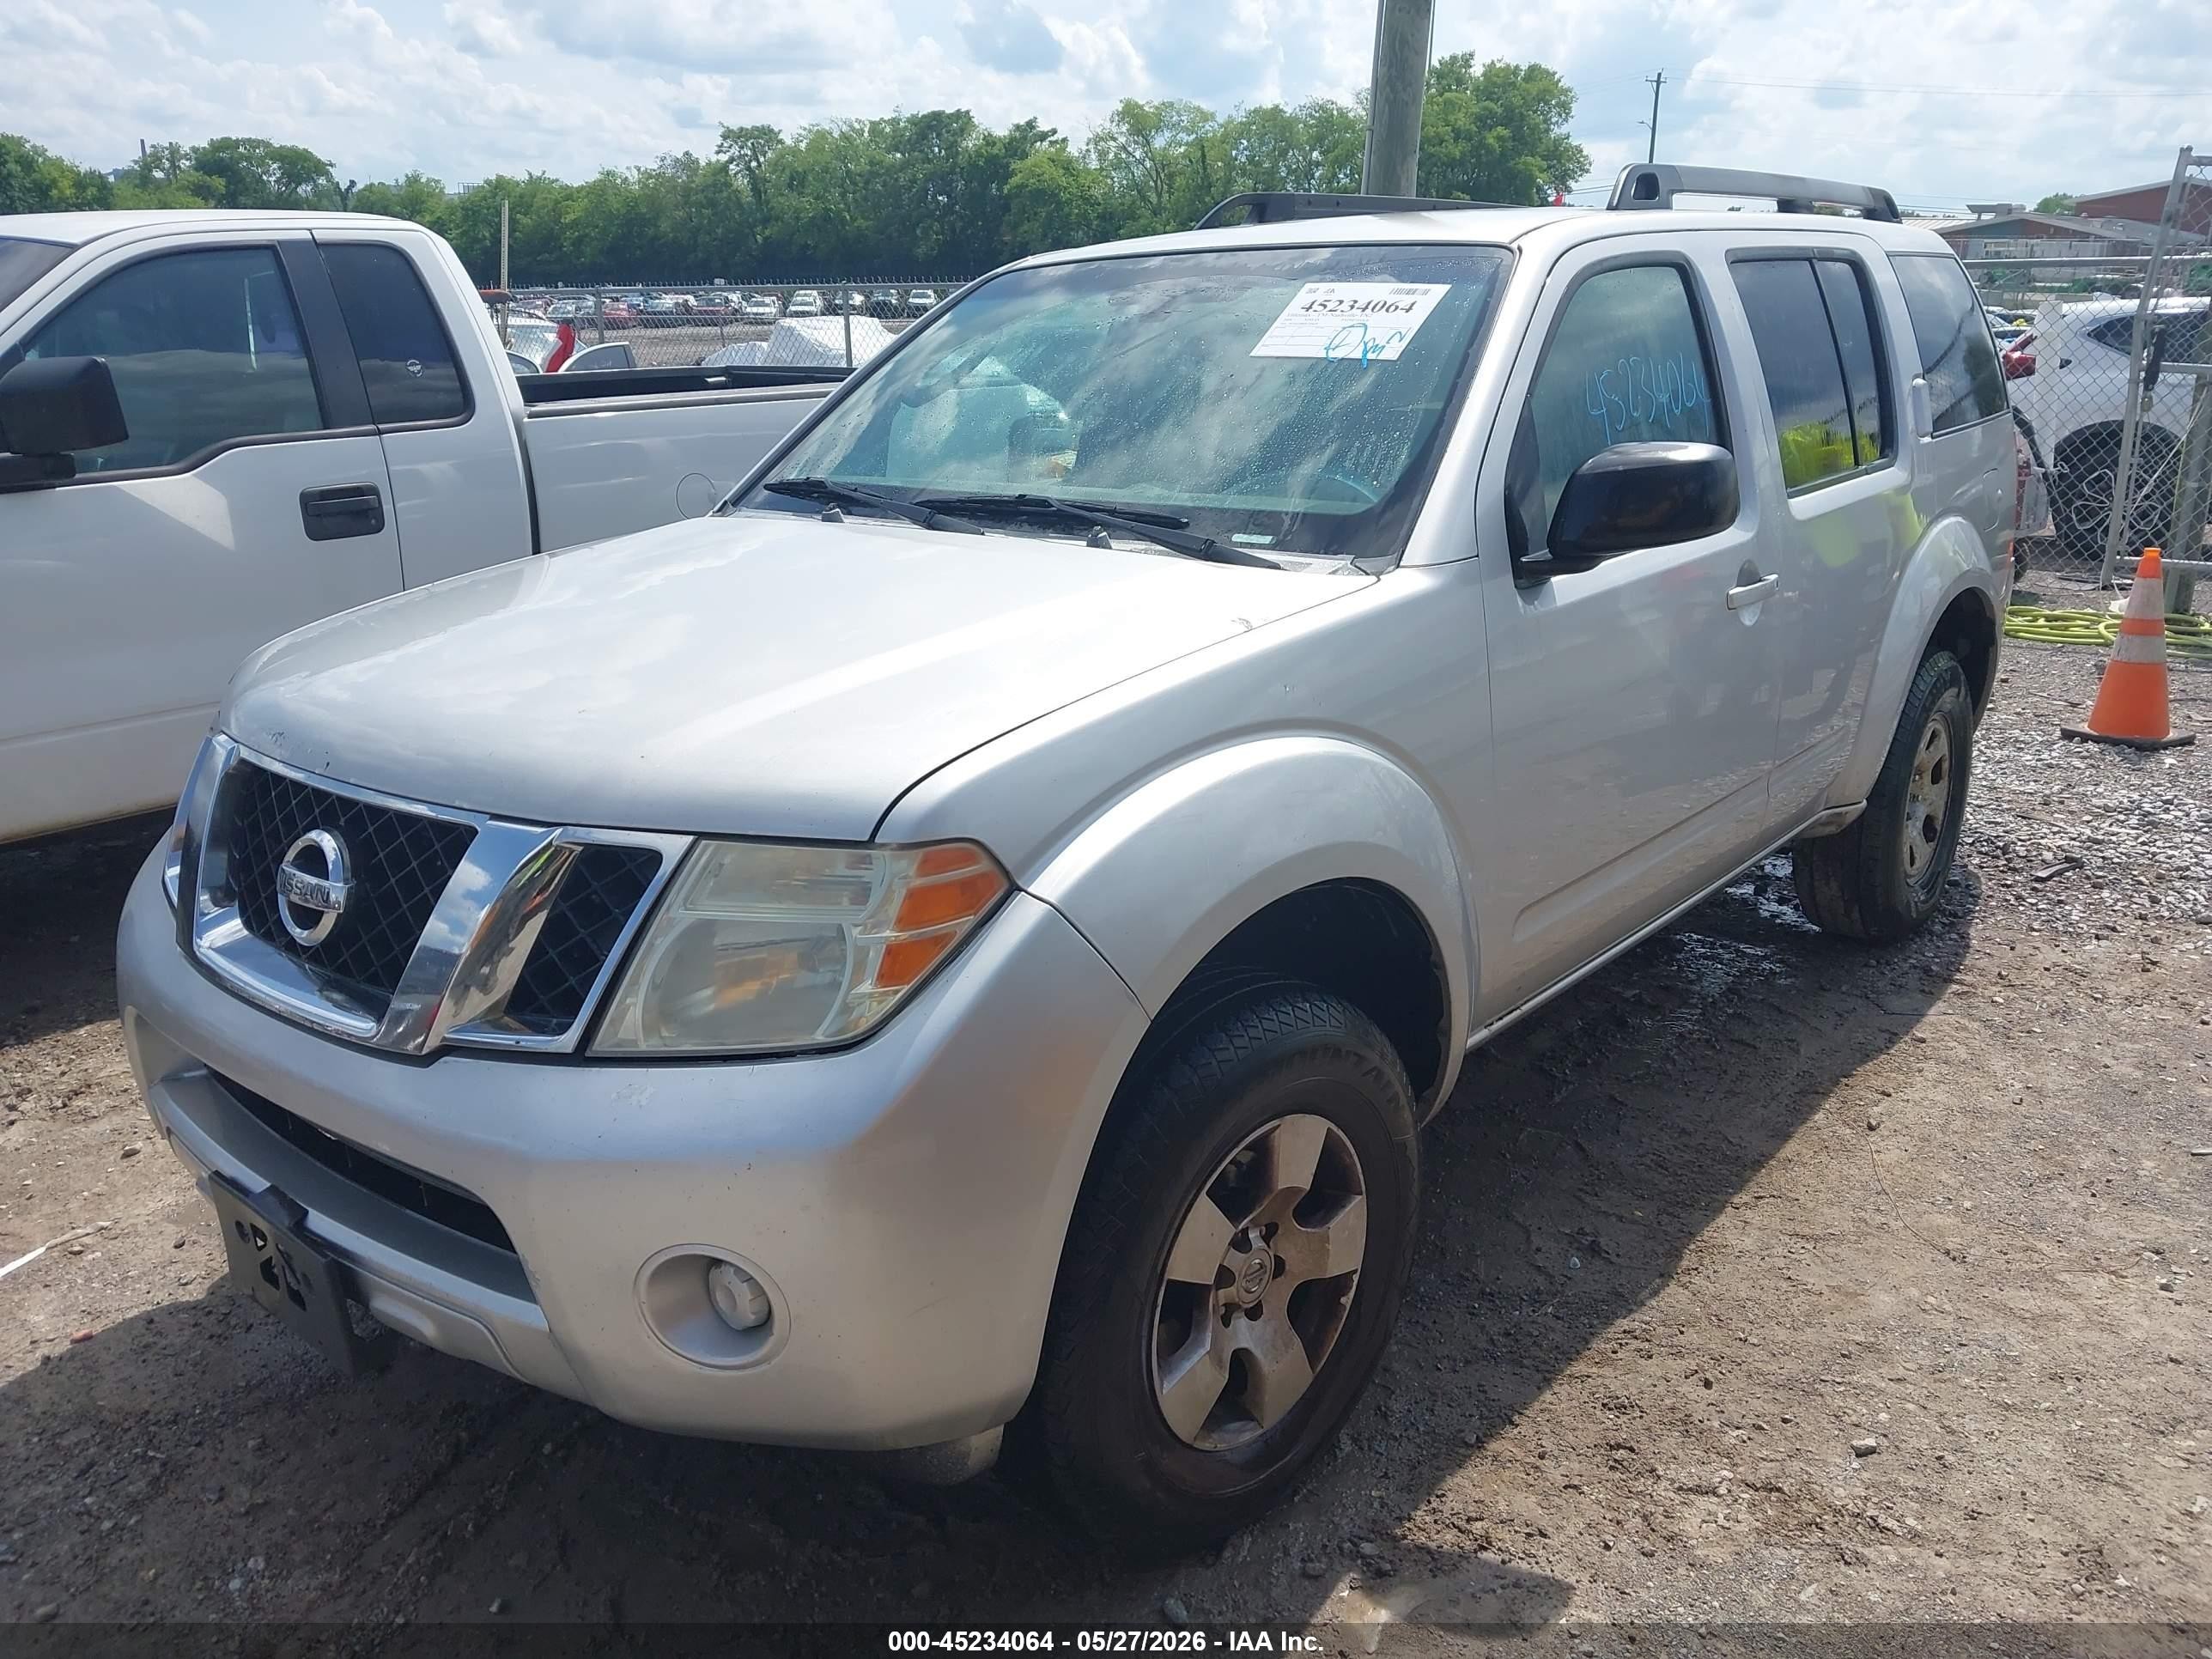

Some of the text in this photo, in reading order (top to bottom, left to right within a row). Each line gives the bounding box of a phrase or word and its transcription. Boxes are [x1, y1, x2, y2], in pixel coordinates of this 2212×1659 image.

[1301, 299, 1418, 313] 45234064
[1585, 353, 1711, 446] 45234064
[279, 869, 331, 904] NISSAN
